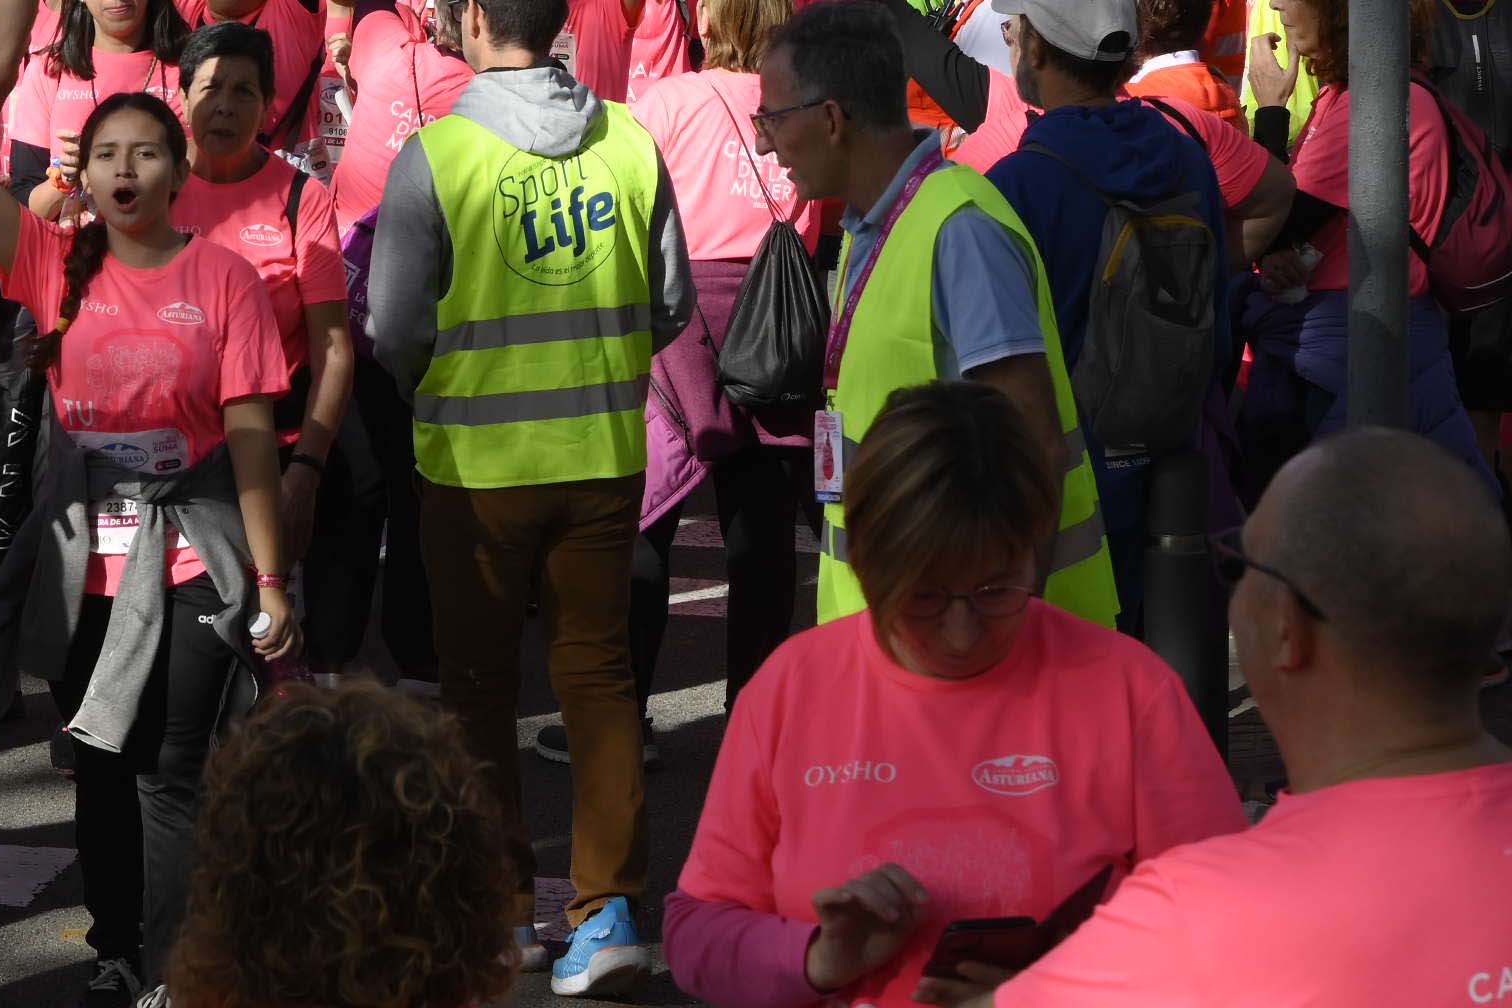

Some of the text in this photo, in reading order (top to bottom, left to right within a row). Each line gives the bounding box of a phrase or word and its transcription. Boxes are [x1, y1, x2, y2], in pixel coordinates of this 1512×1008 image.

[58, 89, 99, 100] OYSHO
[499, 149, 588, 220] Sport
[522, 186, 617, 263] Life
[162, 310, 203, 321] ASTURIANA
[63, 398, 94, 426] TU
[110, 517, 133, 526] DE LA
[804, 759, 897, 787] OYSHO
[979, 766, 1055, 786] ASTURIANA
